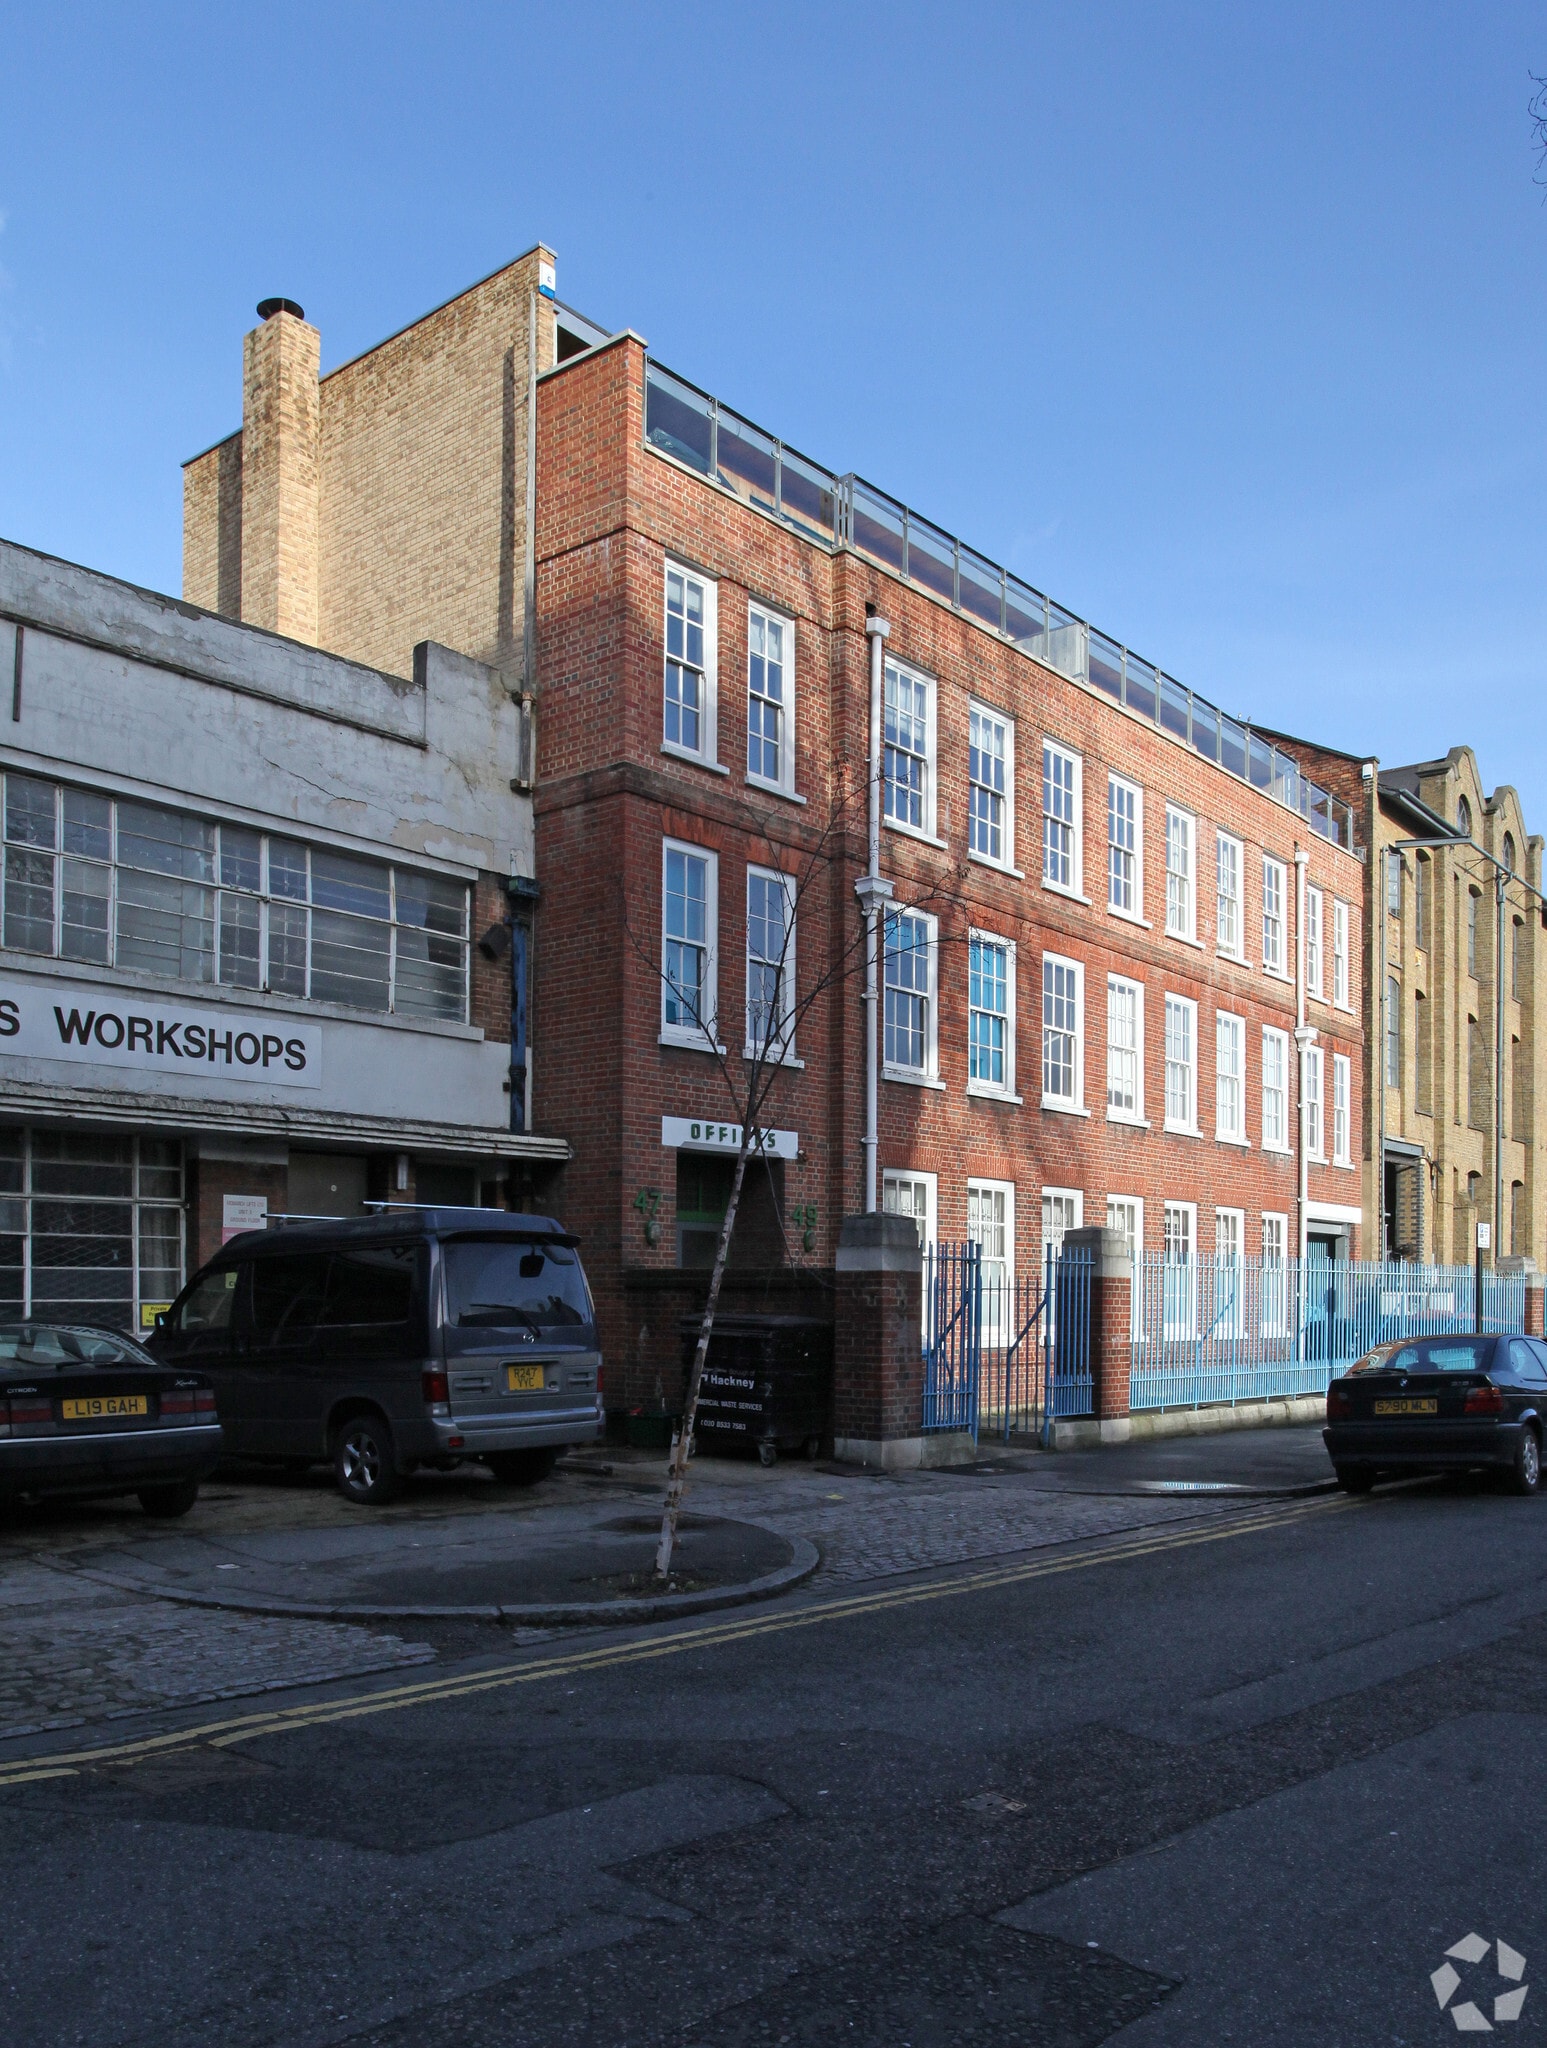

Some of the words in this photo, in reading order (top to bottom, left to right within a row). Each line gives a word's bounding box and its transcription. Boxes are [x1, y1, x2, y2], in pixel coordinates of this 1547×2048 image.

[53, 1006, 306, 1070] WORKSHOPS
[690, 1123, 776, 1148] OFFIS
[633, 1191, 661, 1215] 47
[792, 1205, 818, 1227] 49
[514, 1367, 537, 1377] R247
[711, 1375, 754, 1389] Hackney
[75, 1400, 102, 1416] L19
[106, 1399, 138, 1415] GAH
[739, 1403, 762, 1411] SERVICES
[1377, 1400, 1408, 1412] S790
